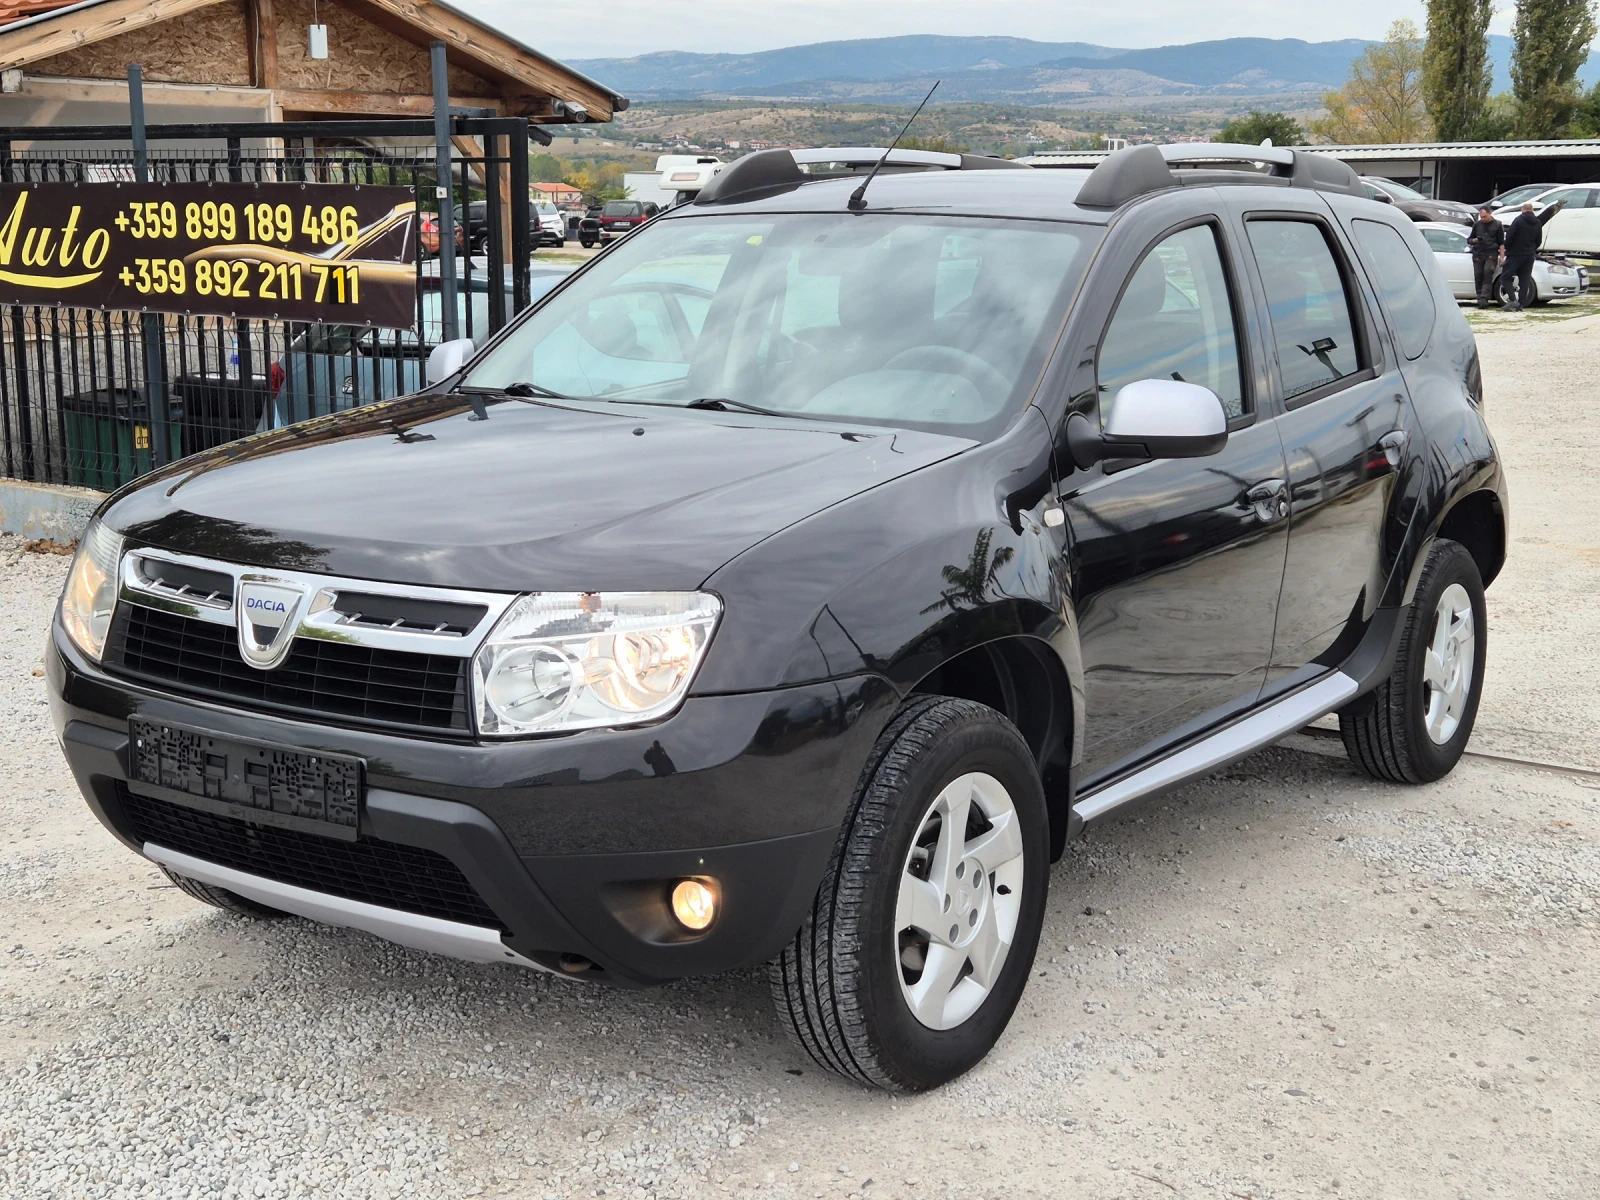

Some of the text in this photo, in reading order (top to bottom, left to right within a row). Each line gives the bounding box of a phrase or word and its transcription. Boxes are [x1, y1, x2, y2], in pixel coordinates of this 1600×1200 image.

[0, 190, 110, 269] Auto
[114, 201, 359, 245] +359 899 189 486
[118, 258, 360, 304] +359 892 211 711
[246, 597, 286, 613] DACIA
